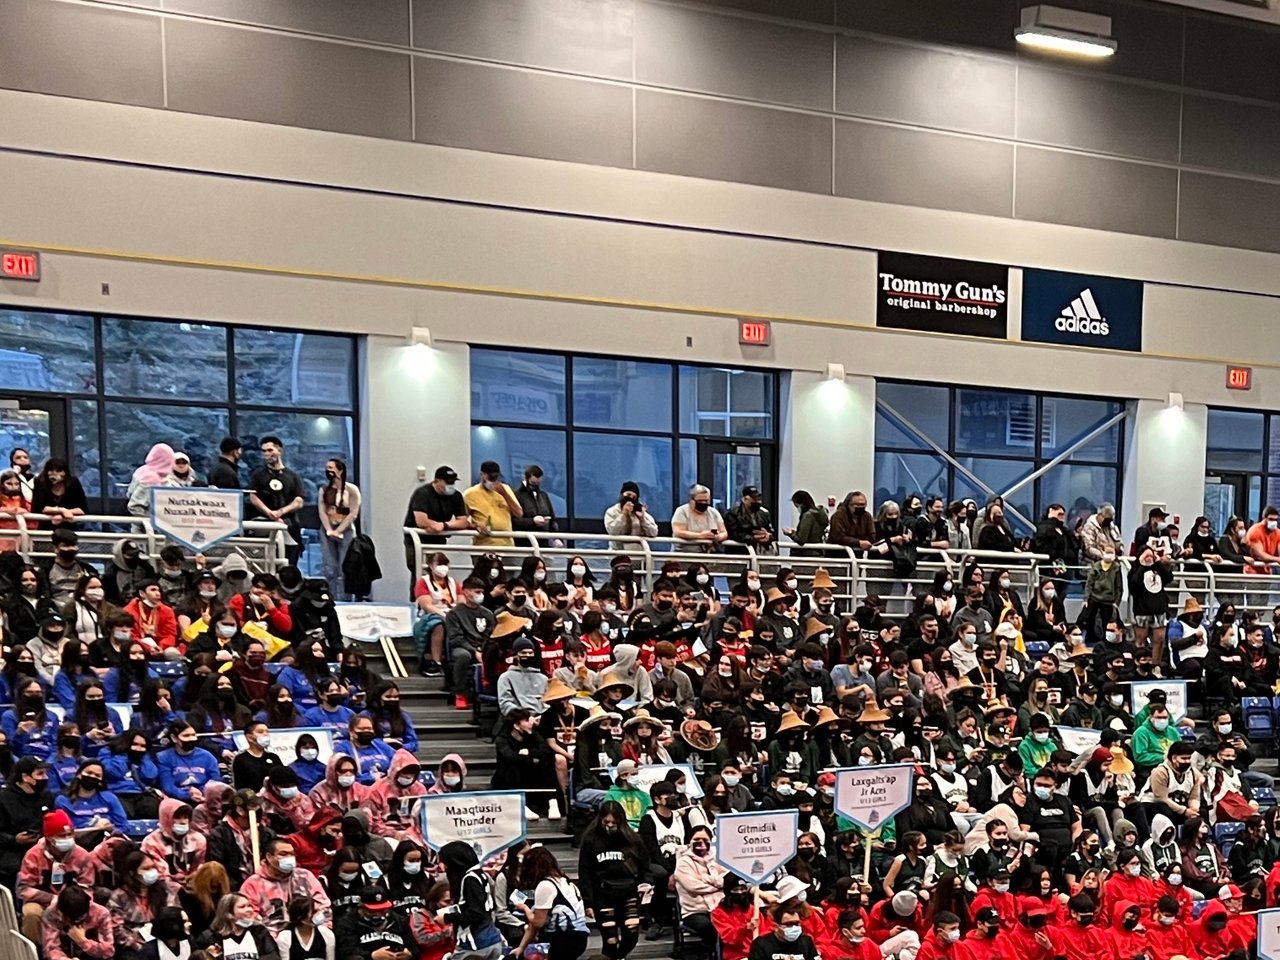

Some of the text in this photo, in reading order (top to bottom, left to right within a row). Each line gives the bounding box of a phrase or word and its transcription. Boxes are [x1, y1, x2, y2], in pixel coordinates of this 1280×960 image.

[3, 253, 36, 276] EXIT
[880, 273, 1006, 304] Tommy Gun's
[887, 296, 998, 319] original barbershop
[743, 323, 767, 342] EXIT
[1055, 317, 1110, 336] adidas
[1230, 369, 1249, 387] EXIT
[199, 510, 232, 519] Nation
[869, 787, 887, 797] Aces
[445, 803, 503, 817] Maaqtusiis
[453, 815, 496, 828] Thunder
[737, 823, 778, 836] Gitmidiik
[743, 836, 771, 847] Sonics
[755, 845, 773, 854] GIRLS
